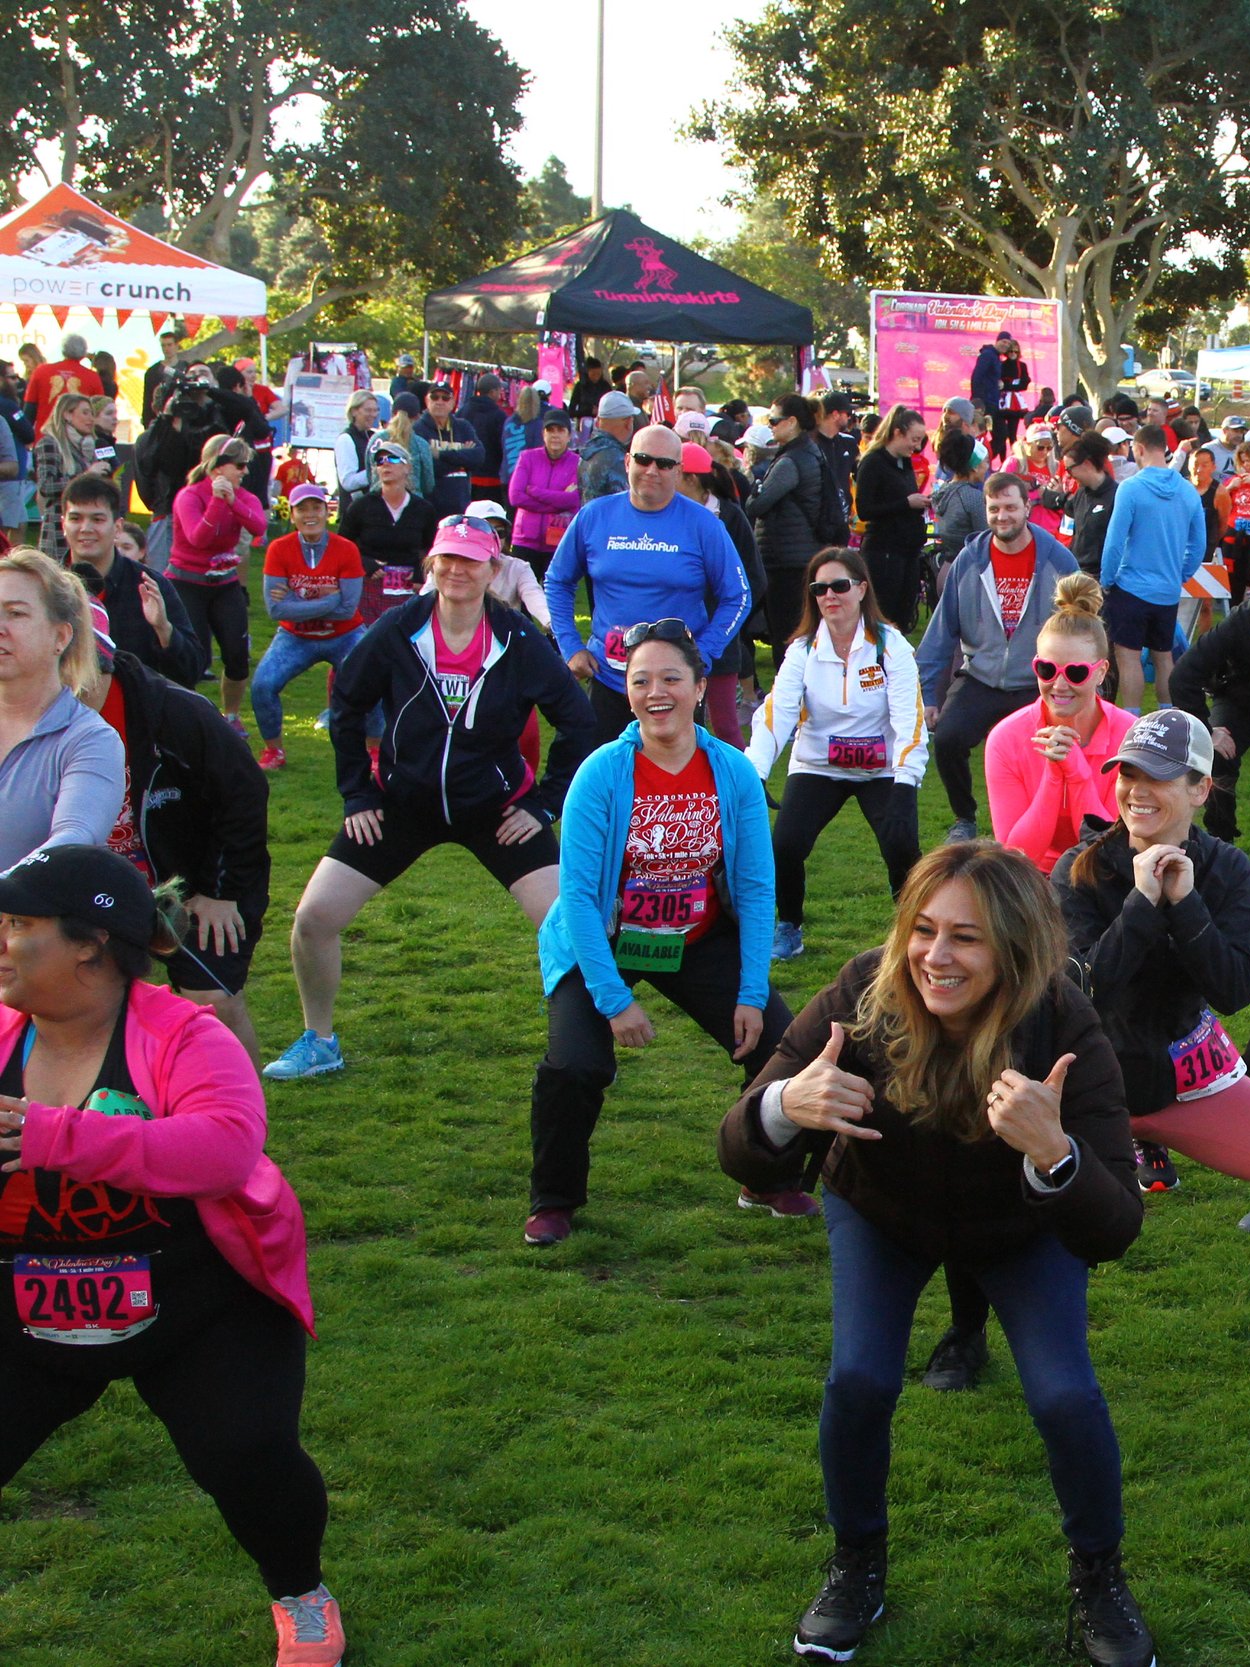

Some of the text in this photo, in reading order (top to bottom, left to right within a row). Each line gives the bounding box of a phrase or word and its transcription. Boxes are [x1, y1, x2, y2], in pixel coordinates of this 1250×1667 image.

[13, 277, 192, 302] power crunch
[594, 289, 741, 305] runningskirts
[927, 300, 981, 317] Valentine's
[983, 303, 1008, 322] Day
[607, 540, 679, 553] ResolutionRun
[608, 633, 627, 657] 25
[833, 746, 876, 766] 2502
[647, 792, 707, 801] CORONADO
[636, 800, 716, 827] Valentine's
[664, 822, 702, 849] Day
[674, 851, 690, 859] mile
[628, 893, 693, 923] 2305
[619, 941, 681, 959] AVAILABLE
[24, 1276, 129, 1321] 2492
